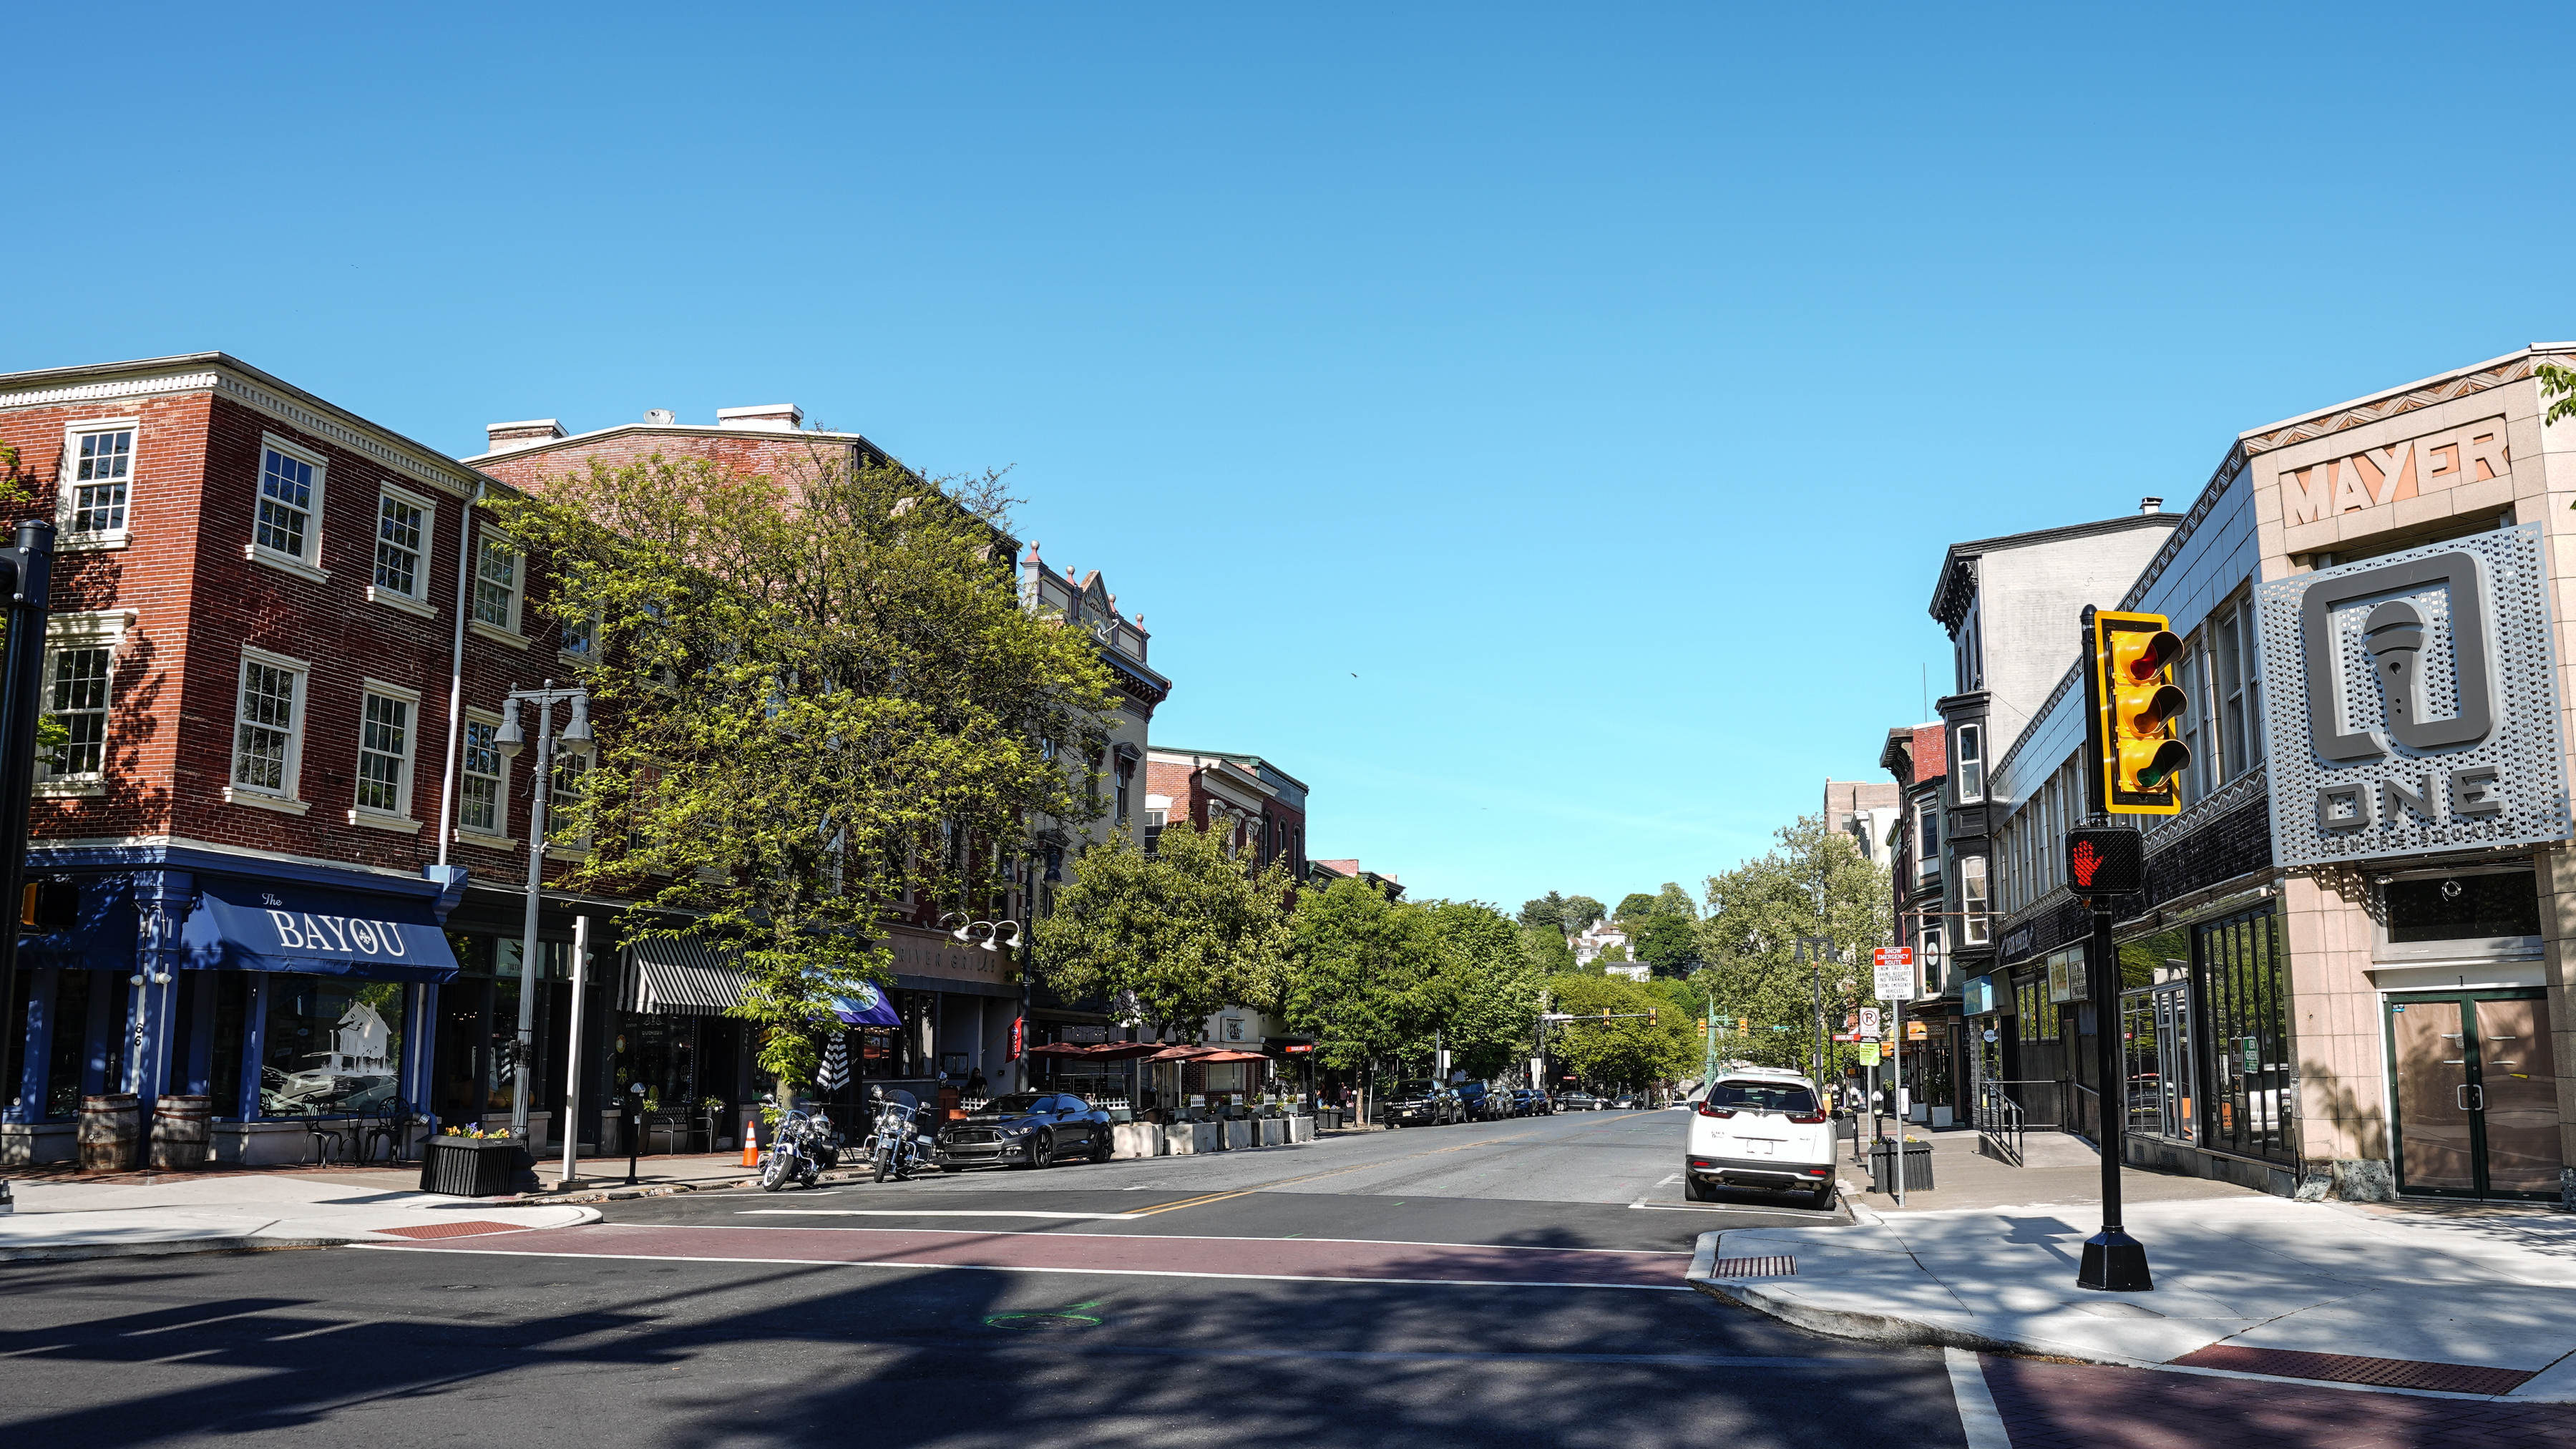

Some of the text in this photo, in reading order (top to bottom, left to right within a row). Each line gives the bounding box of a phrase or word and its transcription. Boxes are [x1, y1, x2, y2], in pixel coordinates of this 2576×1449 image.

[2280, 416, 2512, 528] MAYER
[2318, 766, 2504, 828] ONE
[2321, 822, 2514, 854] CENTRE SQUARE
[262, 893, 283, 906] The
[266, 909, 405, 957] BAYOU
[899, 947, 940, 967] RIVER
[2459, 975, 2464, 987] 1
